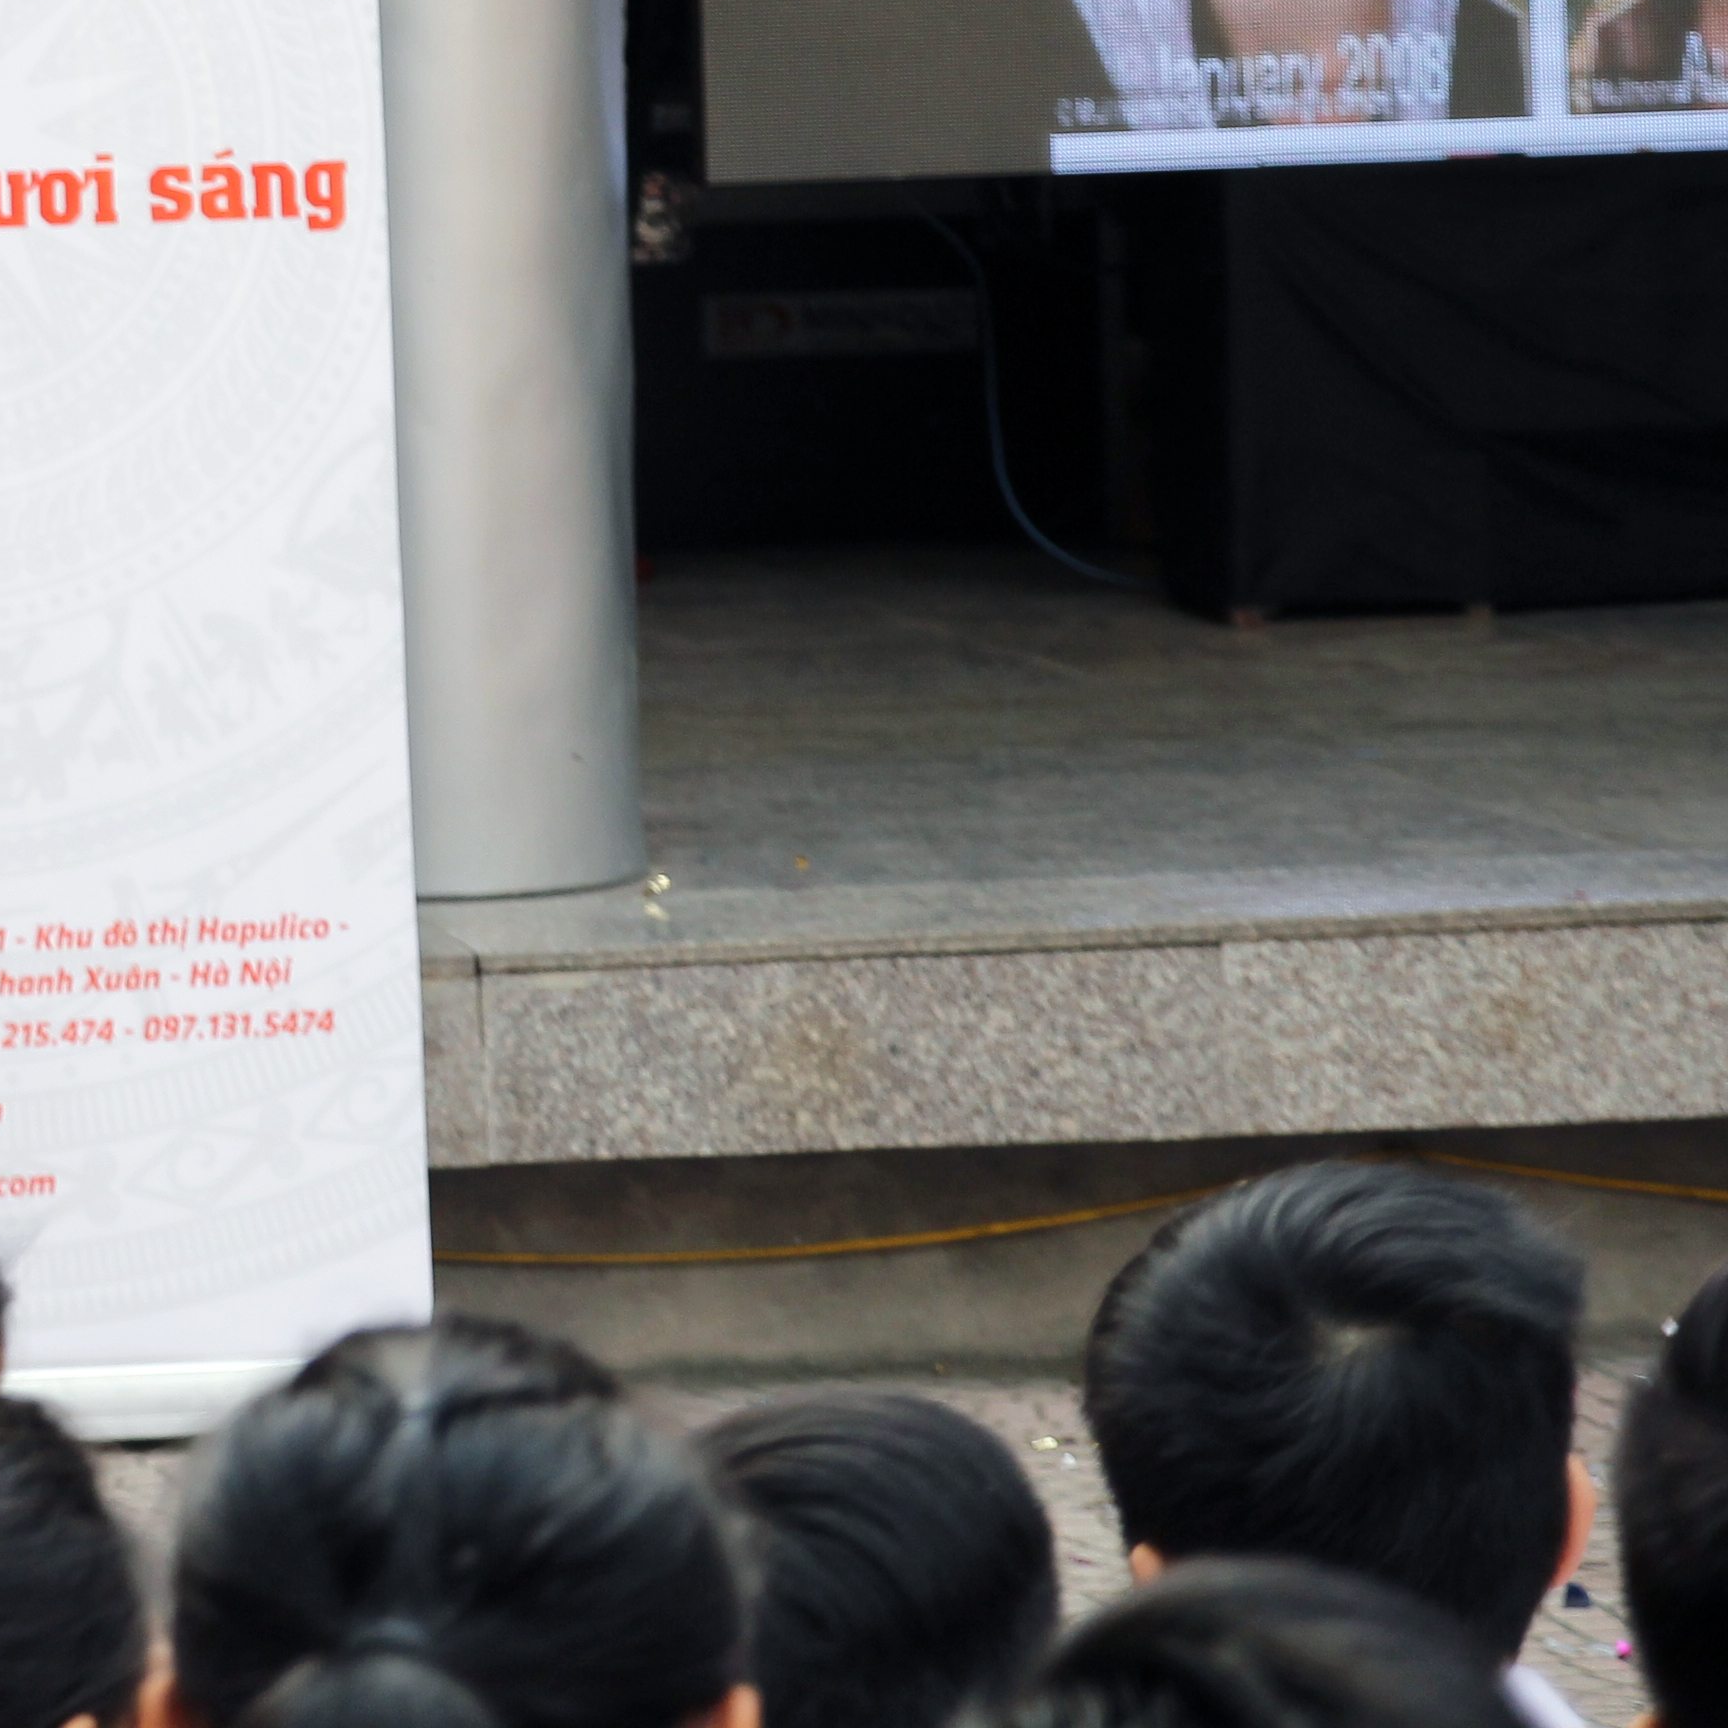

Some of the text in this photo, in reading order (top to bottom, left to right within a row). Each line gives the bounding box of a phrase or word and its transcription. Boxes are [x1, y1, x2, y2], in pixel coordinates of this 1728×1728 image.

[150, 151, 346, 231] sáng
[35, 924, 93, 950] Khu
[147, 919, 188, 946] thị
[197, 914, 330, 947] Hapulico
[84, 965, 161, 992] Xuân
[190, 963, 230, 987] Hà
[240, 960, 291, 987] Nội
[143, 1010, 335, 1042] 097.131.5474
